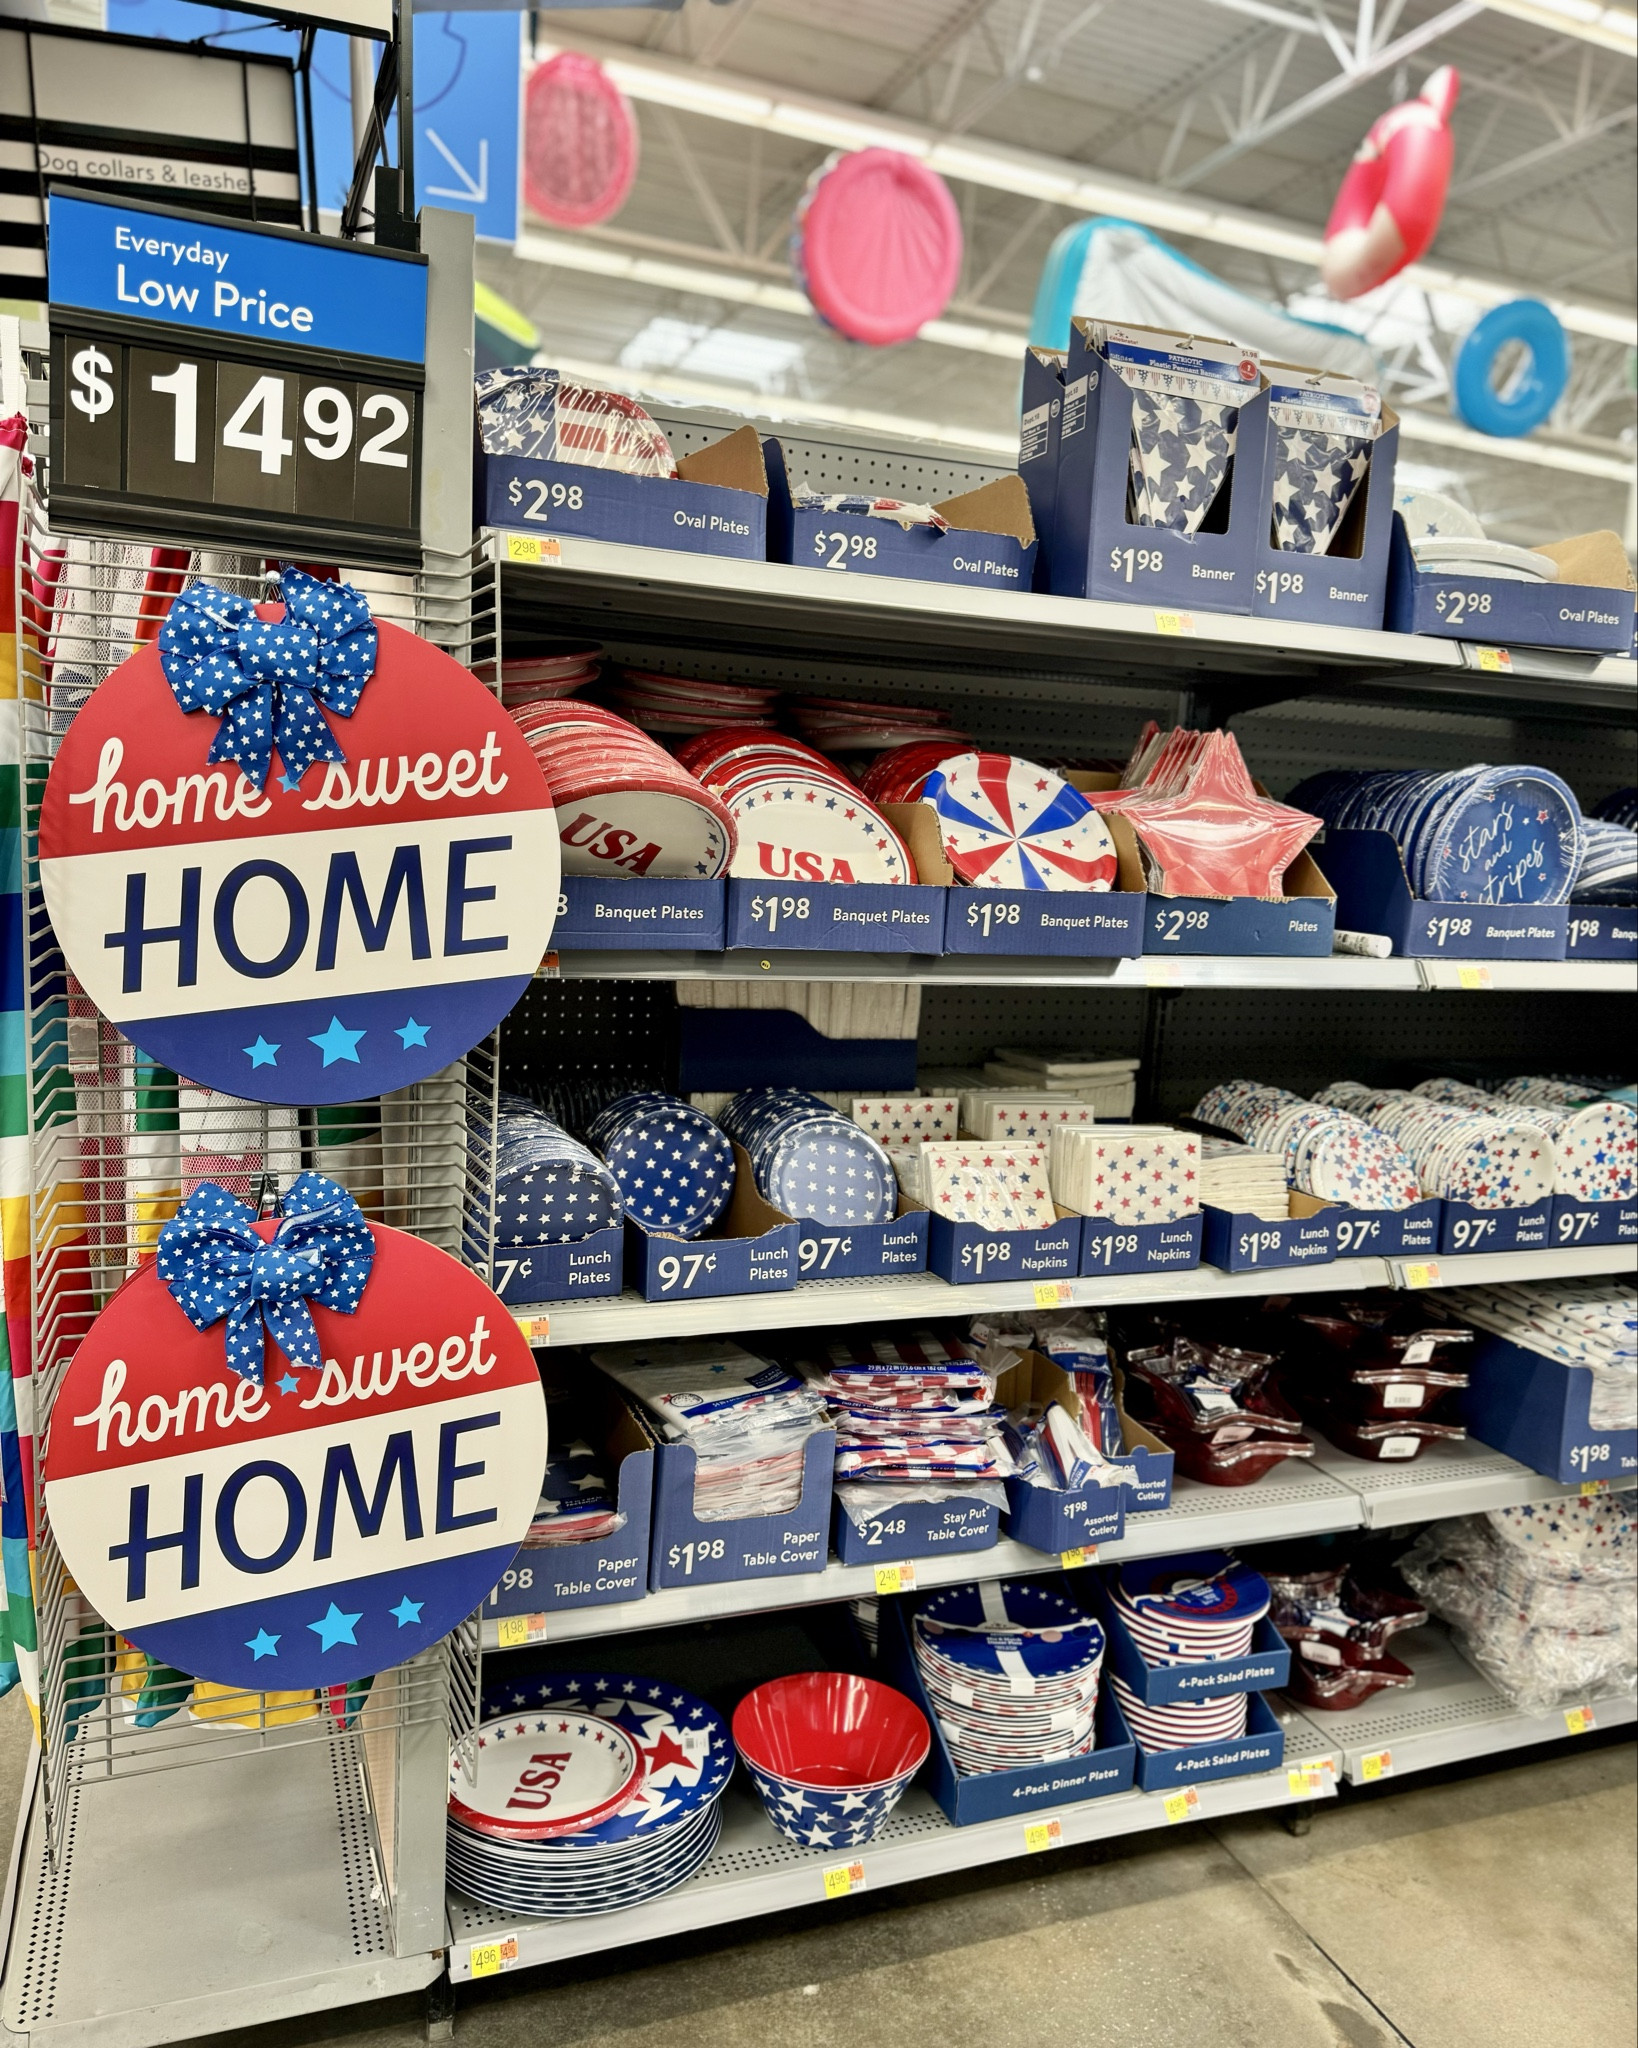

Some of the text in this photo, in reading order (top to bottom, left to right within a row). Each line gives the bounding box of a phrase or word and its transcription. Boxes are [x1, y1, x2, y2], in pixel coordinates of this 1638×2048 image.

[86, 159, 155, 182] collars
[162, 164, 177, 183] &
[115, 227, 230, 273] Everyday
[116, 264, 313, 332] Low Price
[673, 510, 750, 536] Oval Plates
[953, 556, 1019, 579] Oval Plates
[1191, 564, 1235, 581] Banner
[1329, 587, 1369, 603] Banner
[1559, 608, 1620, 626] Oval Plates
[69, 731, 508, 832] home sweet
[560, 812, 663, 876] USA
[1484, 836, 1513, 871] and
[757, 841, 856, 885] USA
[104, 835, 512, 993] HOME
[594, 903, 704, 924] Banquet Plates
[833, 908, 930, 926] Banquet Plates
[1040, 913, 1129, 931] Banquet Plates
[1288, 920, 1318, 933] Plates
[1486, 926, 1556, 939] Banquet Plates
[1519, 1214, 1546, 1227] Lunch
[1620, 1210, 1638, 1220] Lun
[1403, 1217, 1433, 1231] Lunch
[1558, 1212, 1599, 1241] 97¢
[882, 1231, 918, 1246] Lunch
[1160, 1231, 1193, 1244] Lunch
[1300, 1227, 1330, 1240] Lunch
[1336, 1220, 1380, 1252] 97¢
[1402, 1234, 1432, 1247] Plates
[1453, 1219, 1497, 1249] 97¢
[1516, 1230, 1544, 1243] Plates
[1035, 1238, 1069, 1252] Lunch
[1289, 1244, 1328, 1258] Napkins
[569, 1251, 611, 1266] Lunch
[749, 1247, 788, 1262] Lunch
[881, 1250, 917, 1265] Plates
[1147, 1249, 1192, 1263] Napkins
[658, 1252, 717, 1292] 97¢
[1021, 1256, 1068, 1272] Napkins
[568, 1271, 611, 1286] Plates
[749, 1266, 788, 1281] Plates
[74, 1316, 496, 1452] home sweet
[1132, 1479, 1166, 1490] Assorted
[1137, 1492, 1165, 1501] Cutlery
[108, 1411, 500, 1602] HOME
[943, 1511, 967, 1525] Stay
[1084, 1512, 1118, 1526] Assorted
[783, 1531, 820, 1548] Paper
[927, 1524, 989, 1541] Table Cover
[1089, 1525, 1118, 1537] Cutlery
[597, 1557, 639, 1572] Paper
[743, 1549, 819, 1567] Table Cover
[554, 1576, 638, 1597] Table Cover
[1178, 1666, 1275, 1688] 4-Pack Salad Plates
[1175, 1747, 1270, 1772] 4-Pack Salad Plates
[505, 1751, 573, 1810] USA
[1012, 1767, 1119, 1798] 4-Pack Dinner Plates
